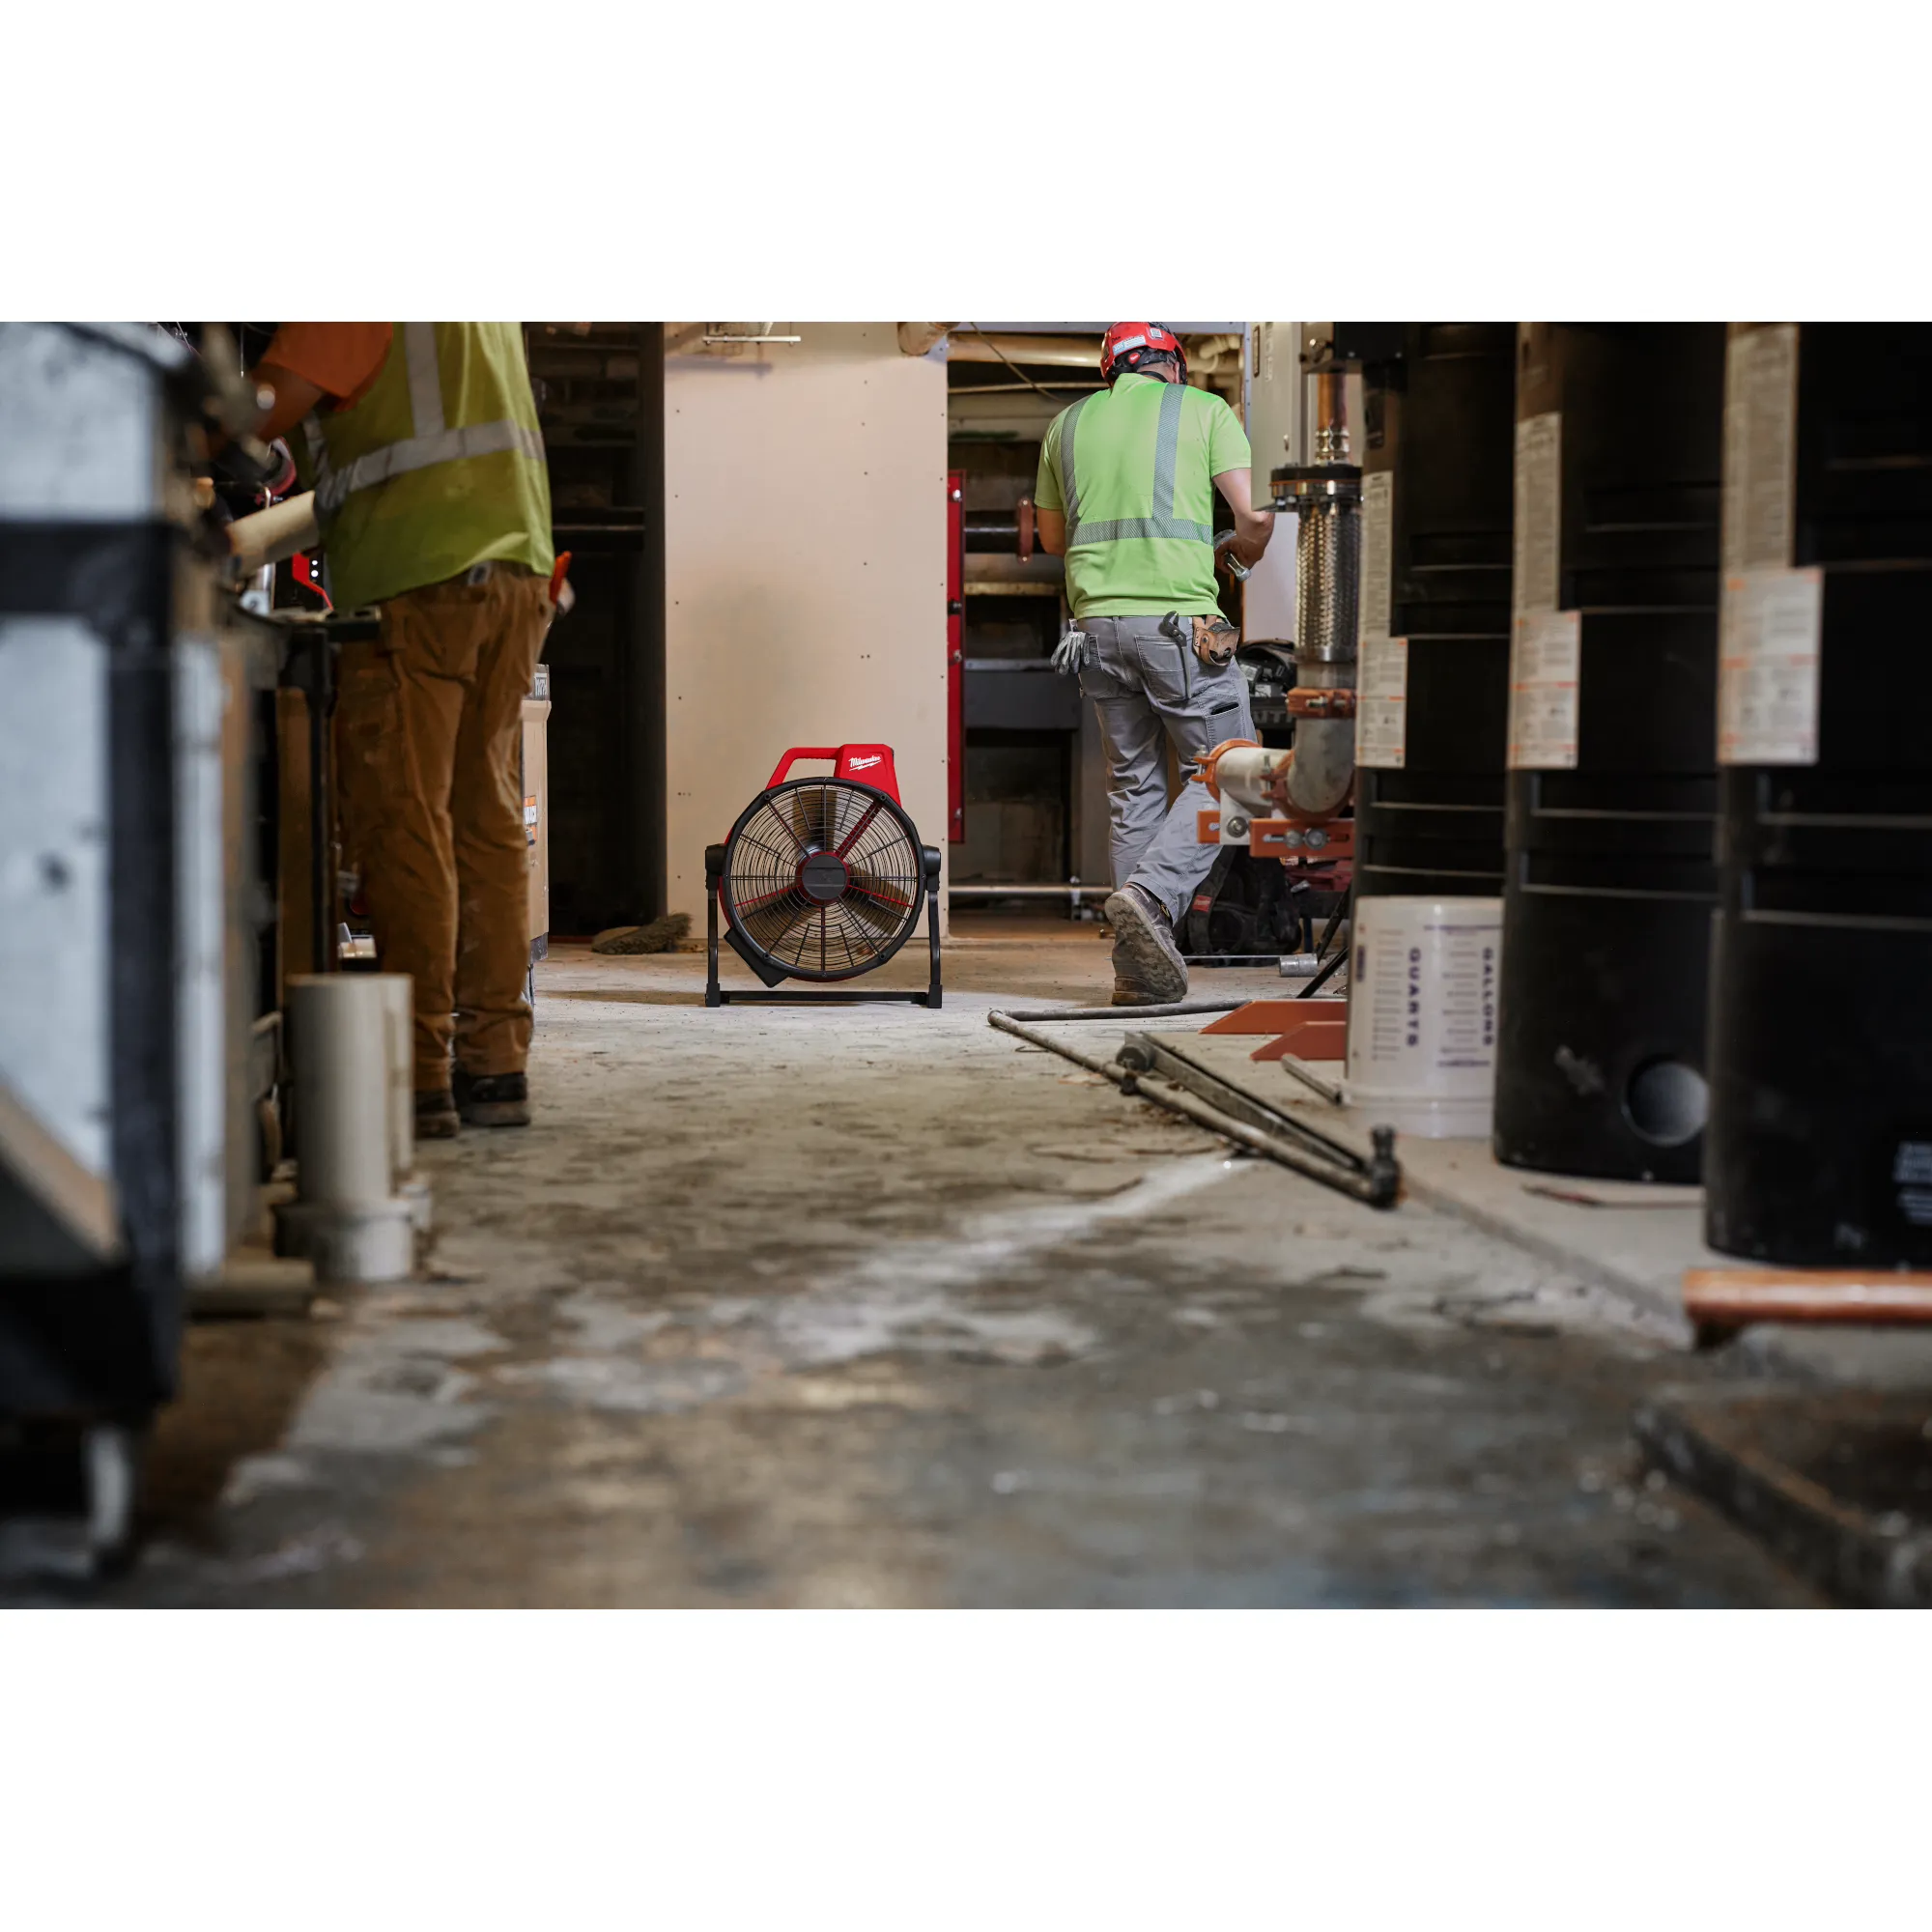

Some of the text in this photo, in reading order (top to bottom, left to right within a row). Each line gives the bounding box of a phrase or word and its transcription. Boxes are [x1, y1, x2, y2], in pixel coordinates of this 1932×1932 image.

[848, 754, 882, 768] Milwaukee
[1406, 947, 1421, 1046] QUARTS
[1482, 947, 1494, 1046] GALLONS
